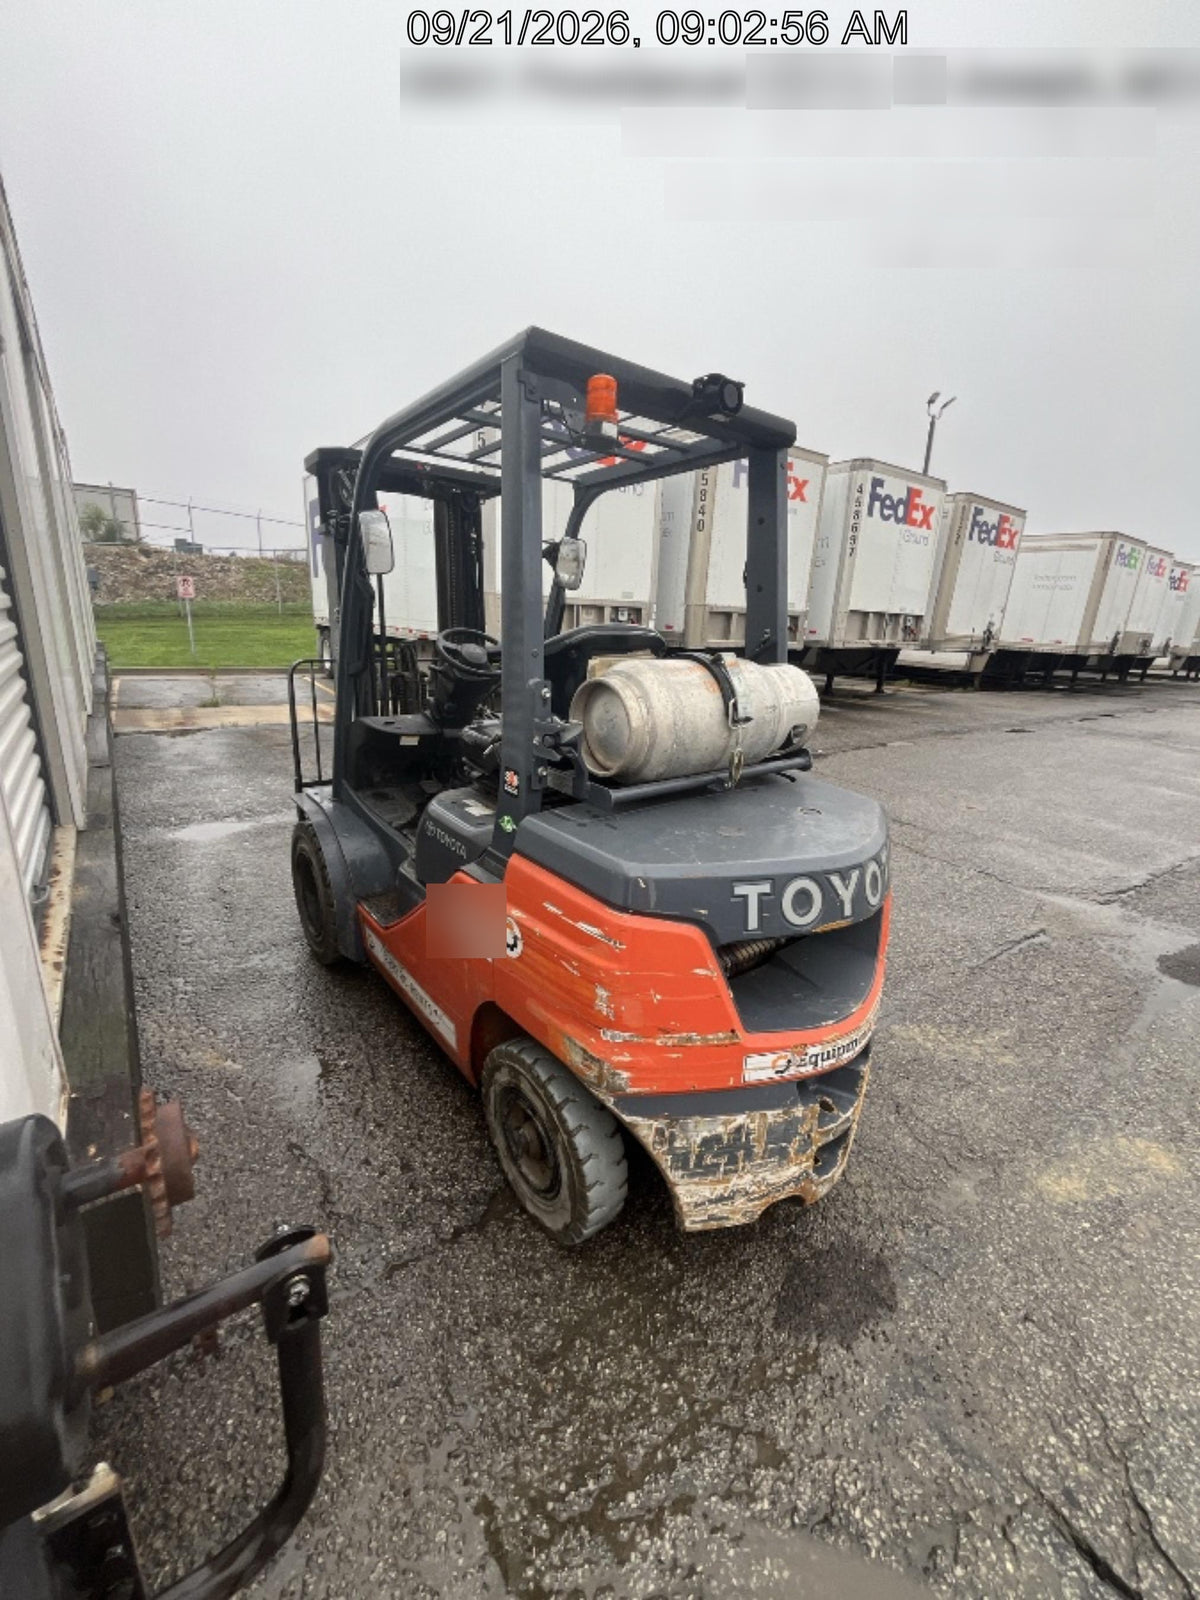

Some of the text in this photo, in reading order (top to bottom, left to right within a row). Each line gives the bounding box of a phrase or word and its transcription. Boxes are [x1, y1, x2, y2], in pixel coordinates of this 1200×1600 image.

[867, 476, 936, 531] FedEx
[968, 506, 1019, 551] FedEx
[733, 850, 888, 932] TOYO
[796, 1037, 859, 1068] Equipm
